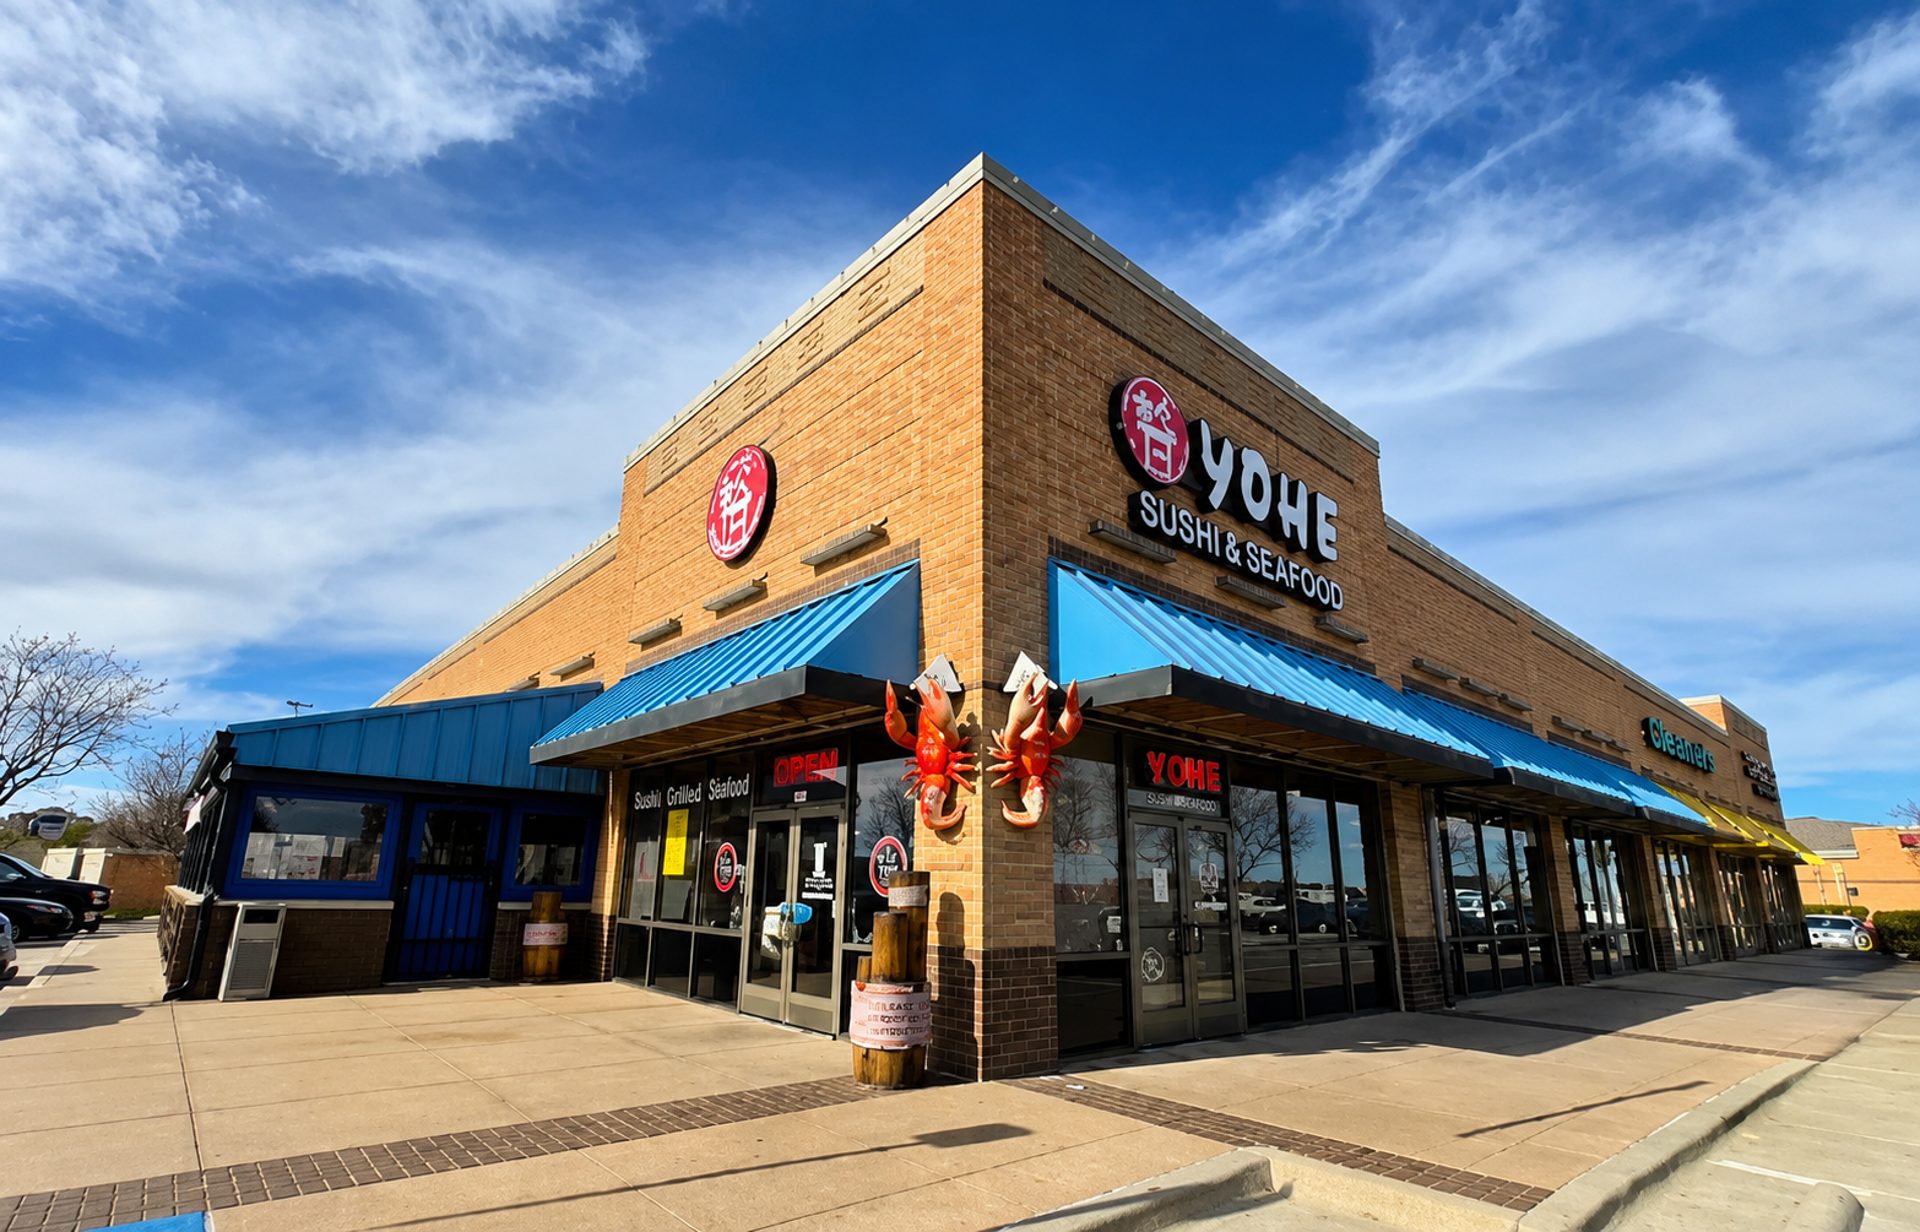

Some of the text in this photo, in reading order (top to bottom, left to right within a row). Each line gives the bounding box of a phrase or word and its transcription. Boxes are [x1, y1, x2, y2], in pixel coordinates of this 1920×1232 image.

[1200, 417, 1340, 562] YOHE
[1139, 489, 1344, 611] SUSHI & SEAFOOD
[774, 749, 838, 786] OPEN
[1648, 716, 1717, 774] Cleaners
[666, 782, 702, 807] Grilled
[708, 772, 750, 801] Seafood
[1146, 750, 1222, 792] YOHE
